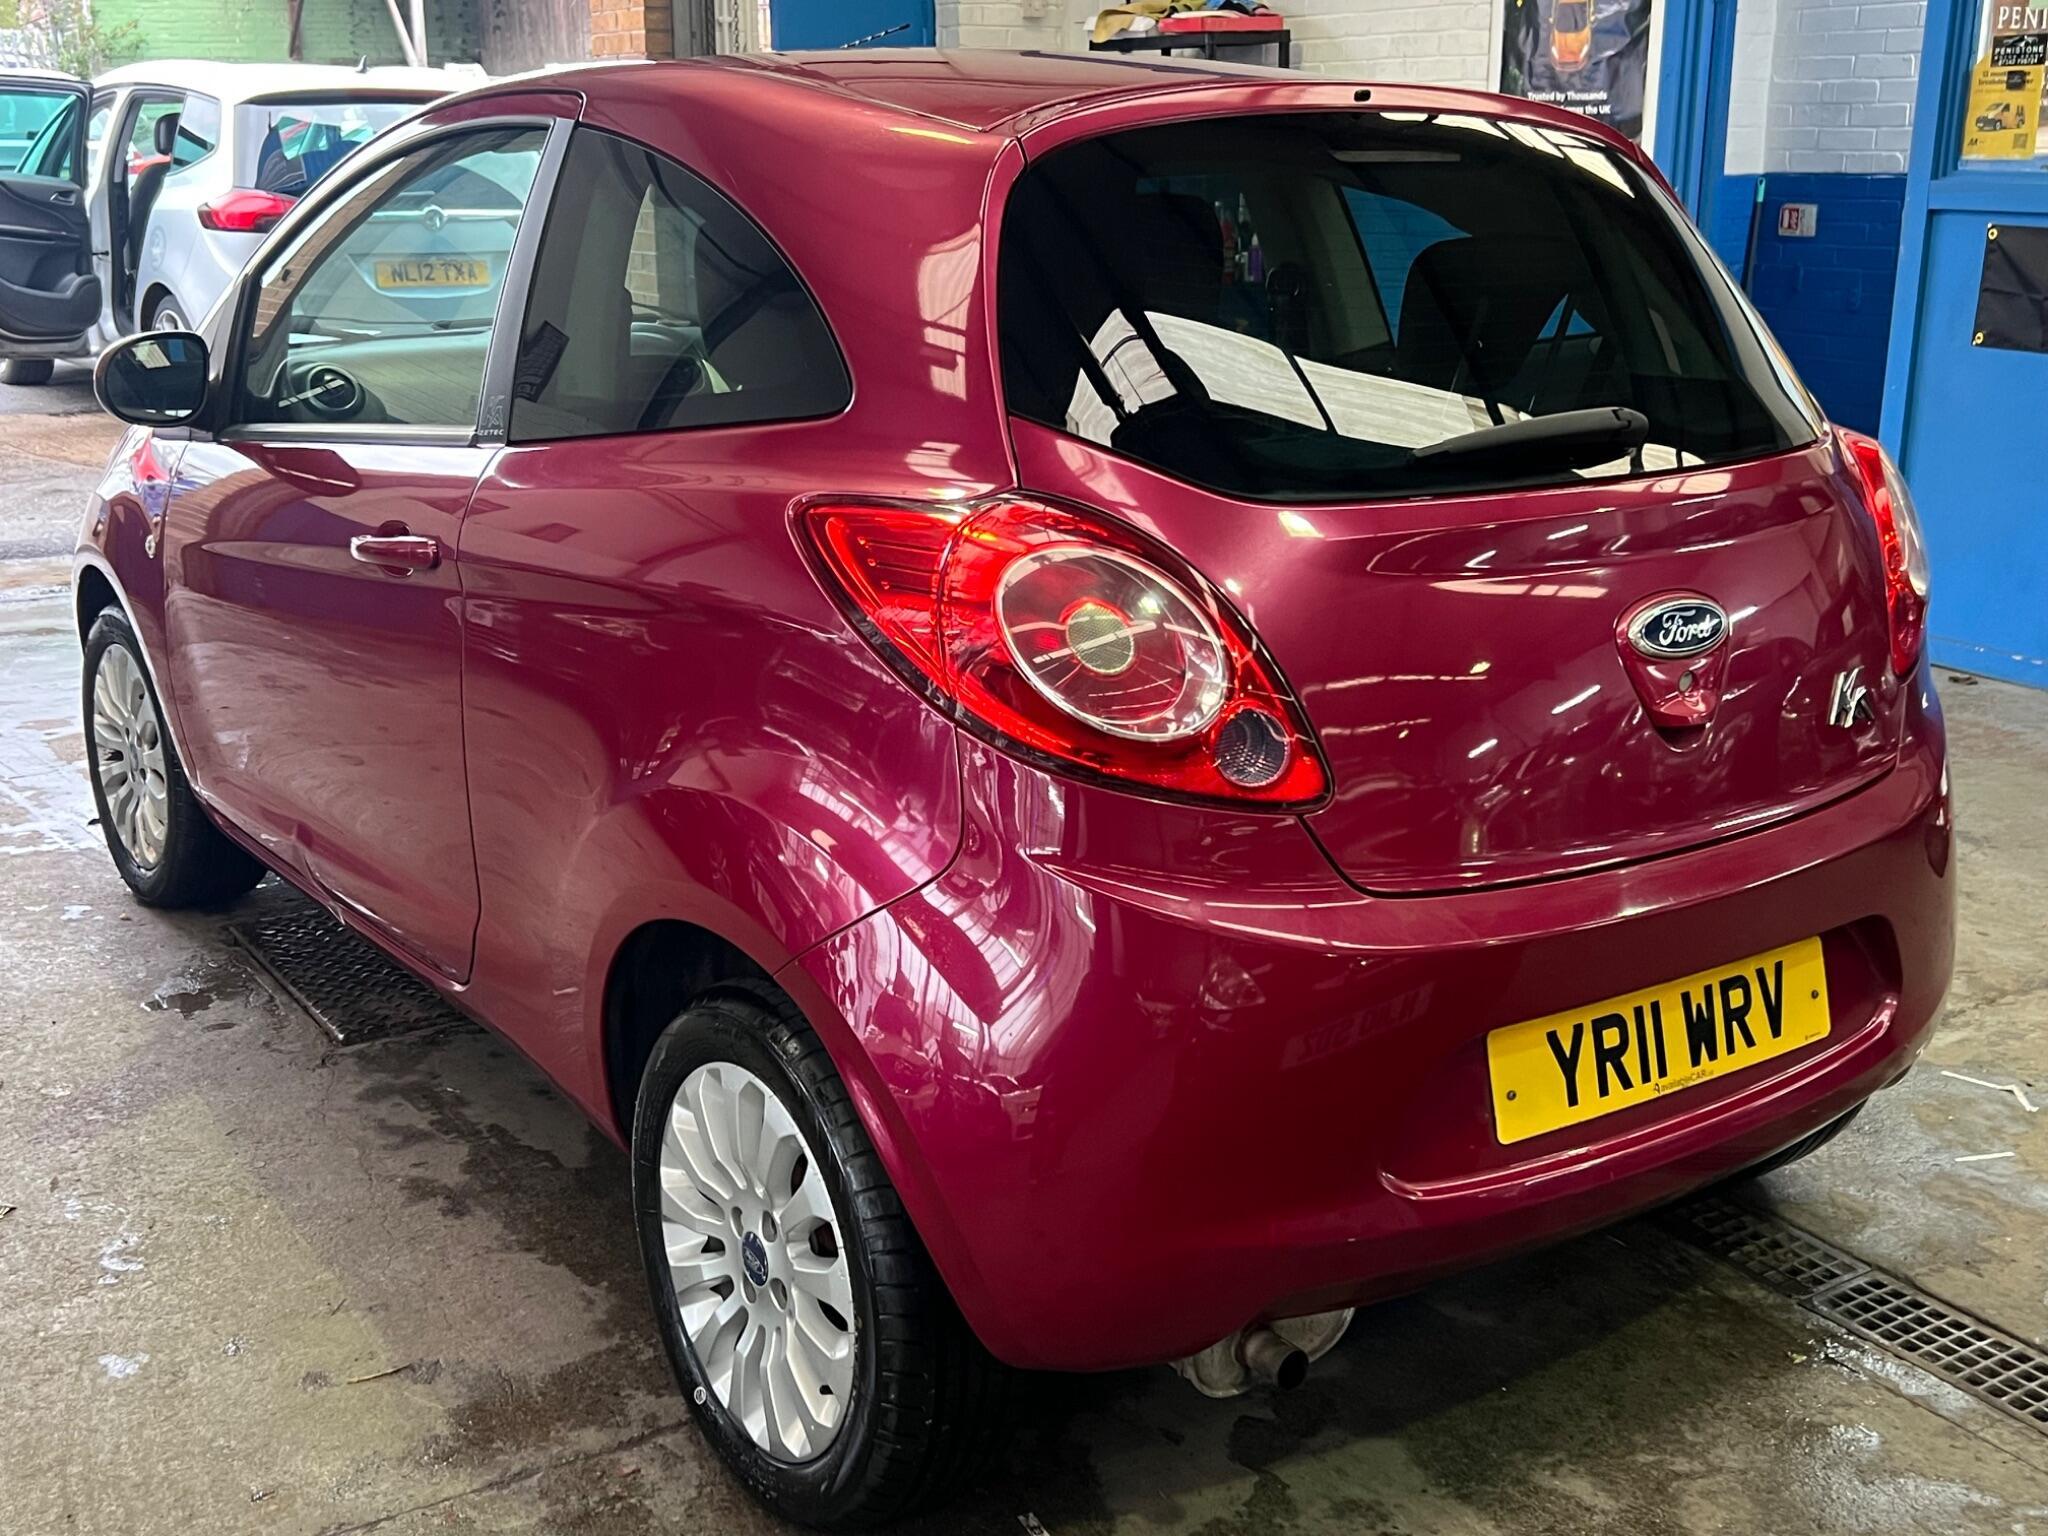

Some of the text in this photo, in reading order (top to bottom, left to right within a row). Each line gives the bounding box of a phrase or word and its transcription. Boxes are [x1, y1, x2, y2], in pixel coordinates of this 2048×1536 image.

[1998, 6, 2048, 30] PENI
[1995, 45, 2044, 55] PENISTONE
[1528, 90, 1607, 102] Trusted by Thousands
[1585, 105, 1598, 114] the
[1599, 105, 1611, 114] UK
[391, 263, 435, 283] NL12
[1658, 609, 1720, 646] Ford
[1546, 960, 1784, 1108] YR11 WRV
